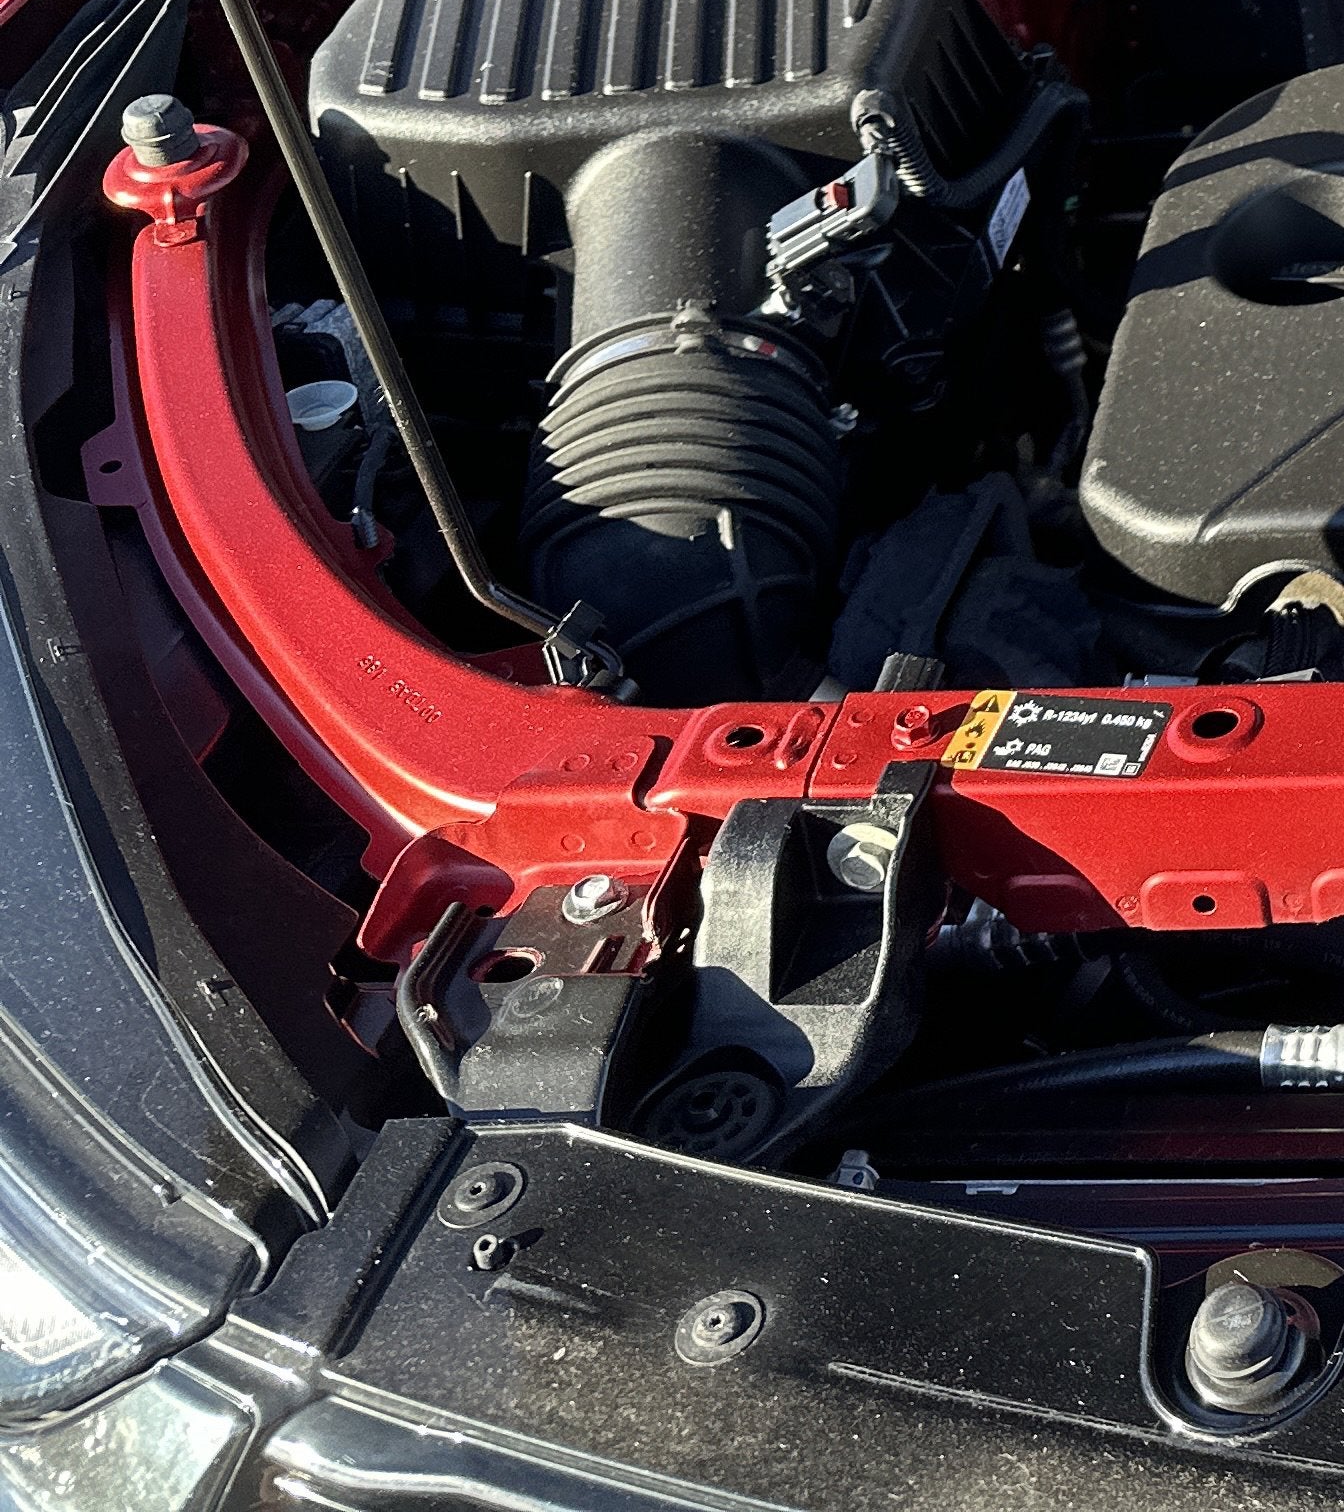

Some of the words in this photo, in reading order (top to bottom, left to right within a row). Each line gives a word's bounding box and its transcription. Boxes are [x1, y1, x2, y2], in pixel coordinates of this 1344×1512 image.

[1043, 709, 1098, 725] R-1234yf
[1134, 716, 1153, 730] kg
[1024, 743, 1052, 756] PAG
